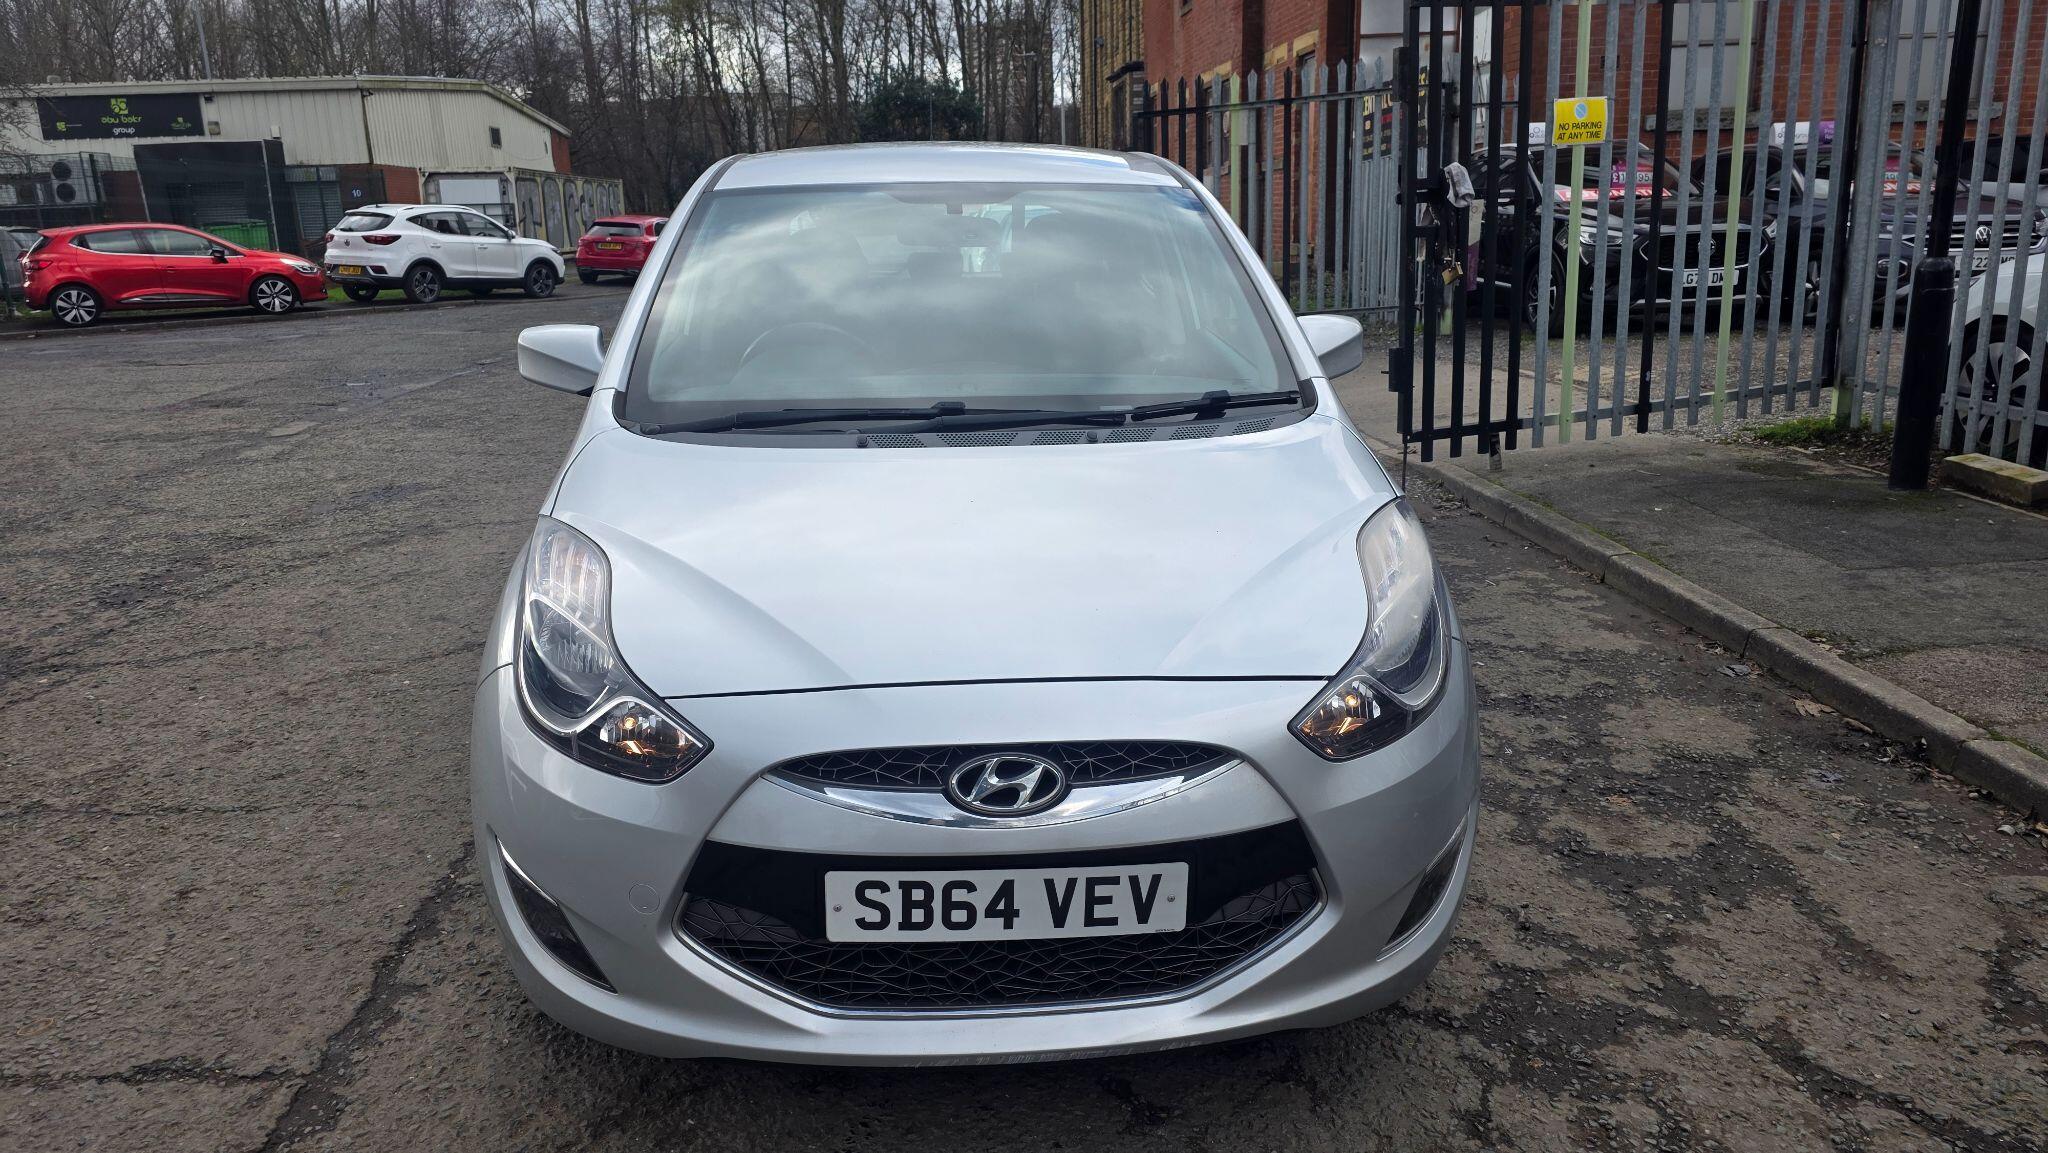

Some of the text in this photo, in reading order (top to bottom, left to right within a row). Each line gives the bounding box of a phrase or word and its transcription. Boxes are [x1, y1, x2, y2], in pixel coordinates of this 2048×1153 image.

[101, 116, 119, 124] abu
[1559, 121, 1602, 131] NO PARKING
[113, 127, 136, 135] group
[1557, 130, 1602, 141] AT ANY TIME
[352, 189, 361, 197] 10
[854, 873, 1163, 932] SB64 VEV
